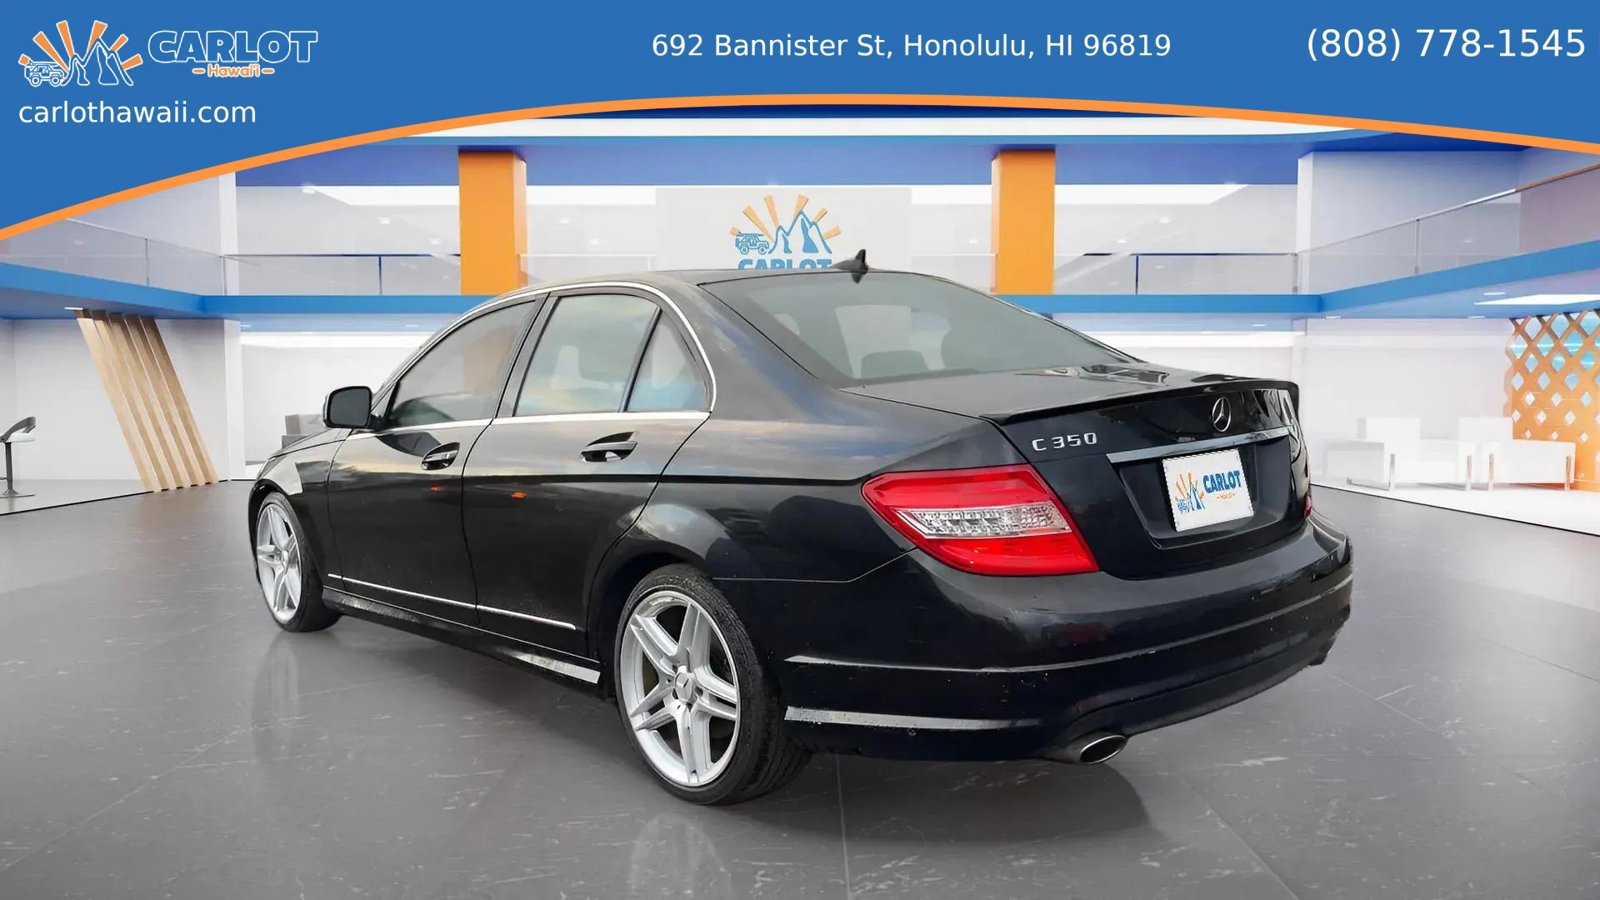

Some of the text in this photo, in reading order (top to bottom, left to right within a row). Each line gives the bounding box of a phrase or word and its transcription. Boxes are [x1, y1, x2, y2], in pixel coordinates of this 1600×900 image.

[1031, 432, 1098, 452] C 350
[1202, 470, 1242, 494] CARLOT
